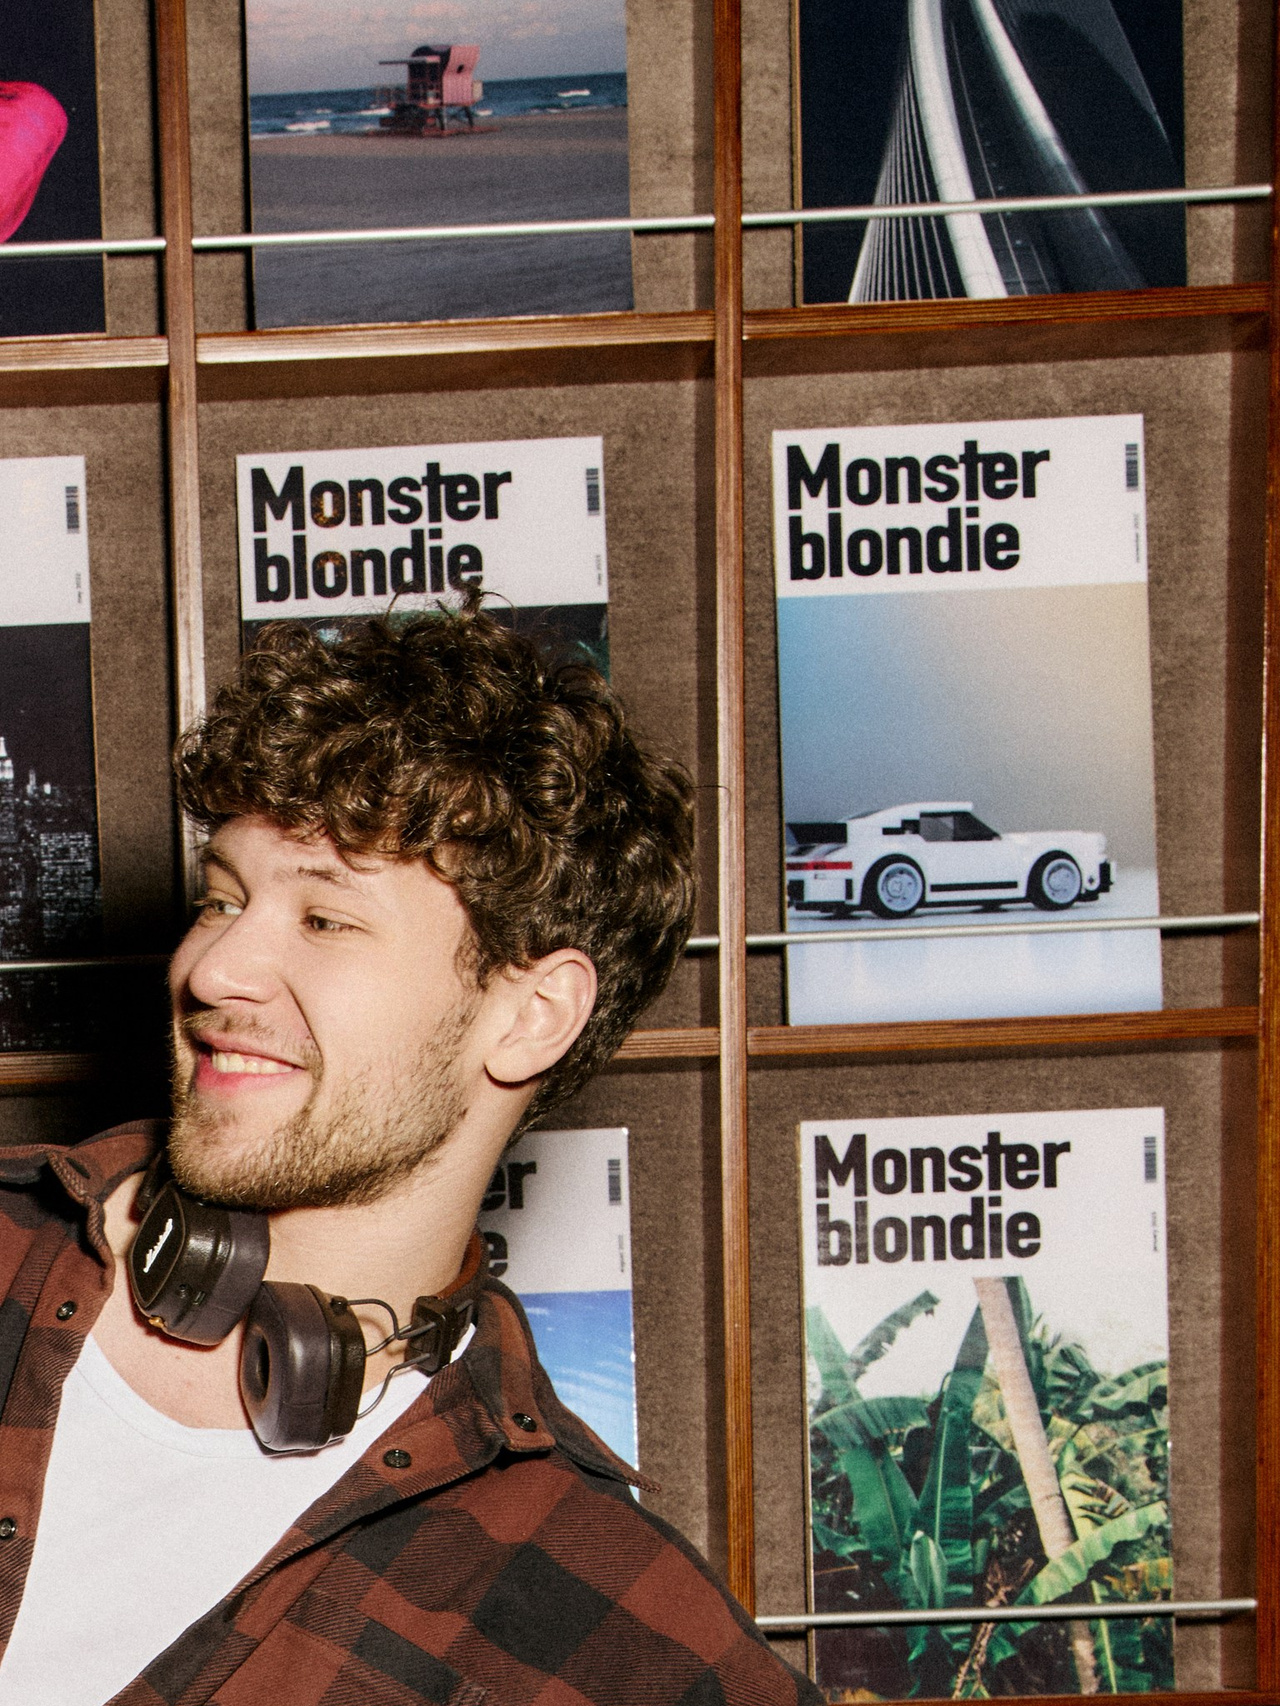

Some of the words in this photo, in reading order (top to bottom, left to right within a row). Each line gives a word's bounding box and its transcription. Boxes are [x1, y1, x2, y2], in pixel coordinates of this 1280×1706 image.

[251, 462, 513, 532] Monster
[787, 440, 1051, 511] Monster
[253, 528, 483, 604] blondie
[789, 507, 1020, 581] blondie
[815, 1132, 1071, 1199] Monster
[816, 1196, 1041, 1266] blondie
